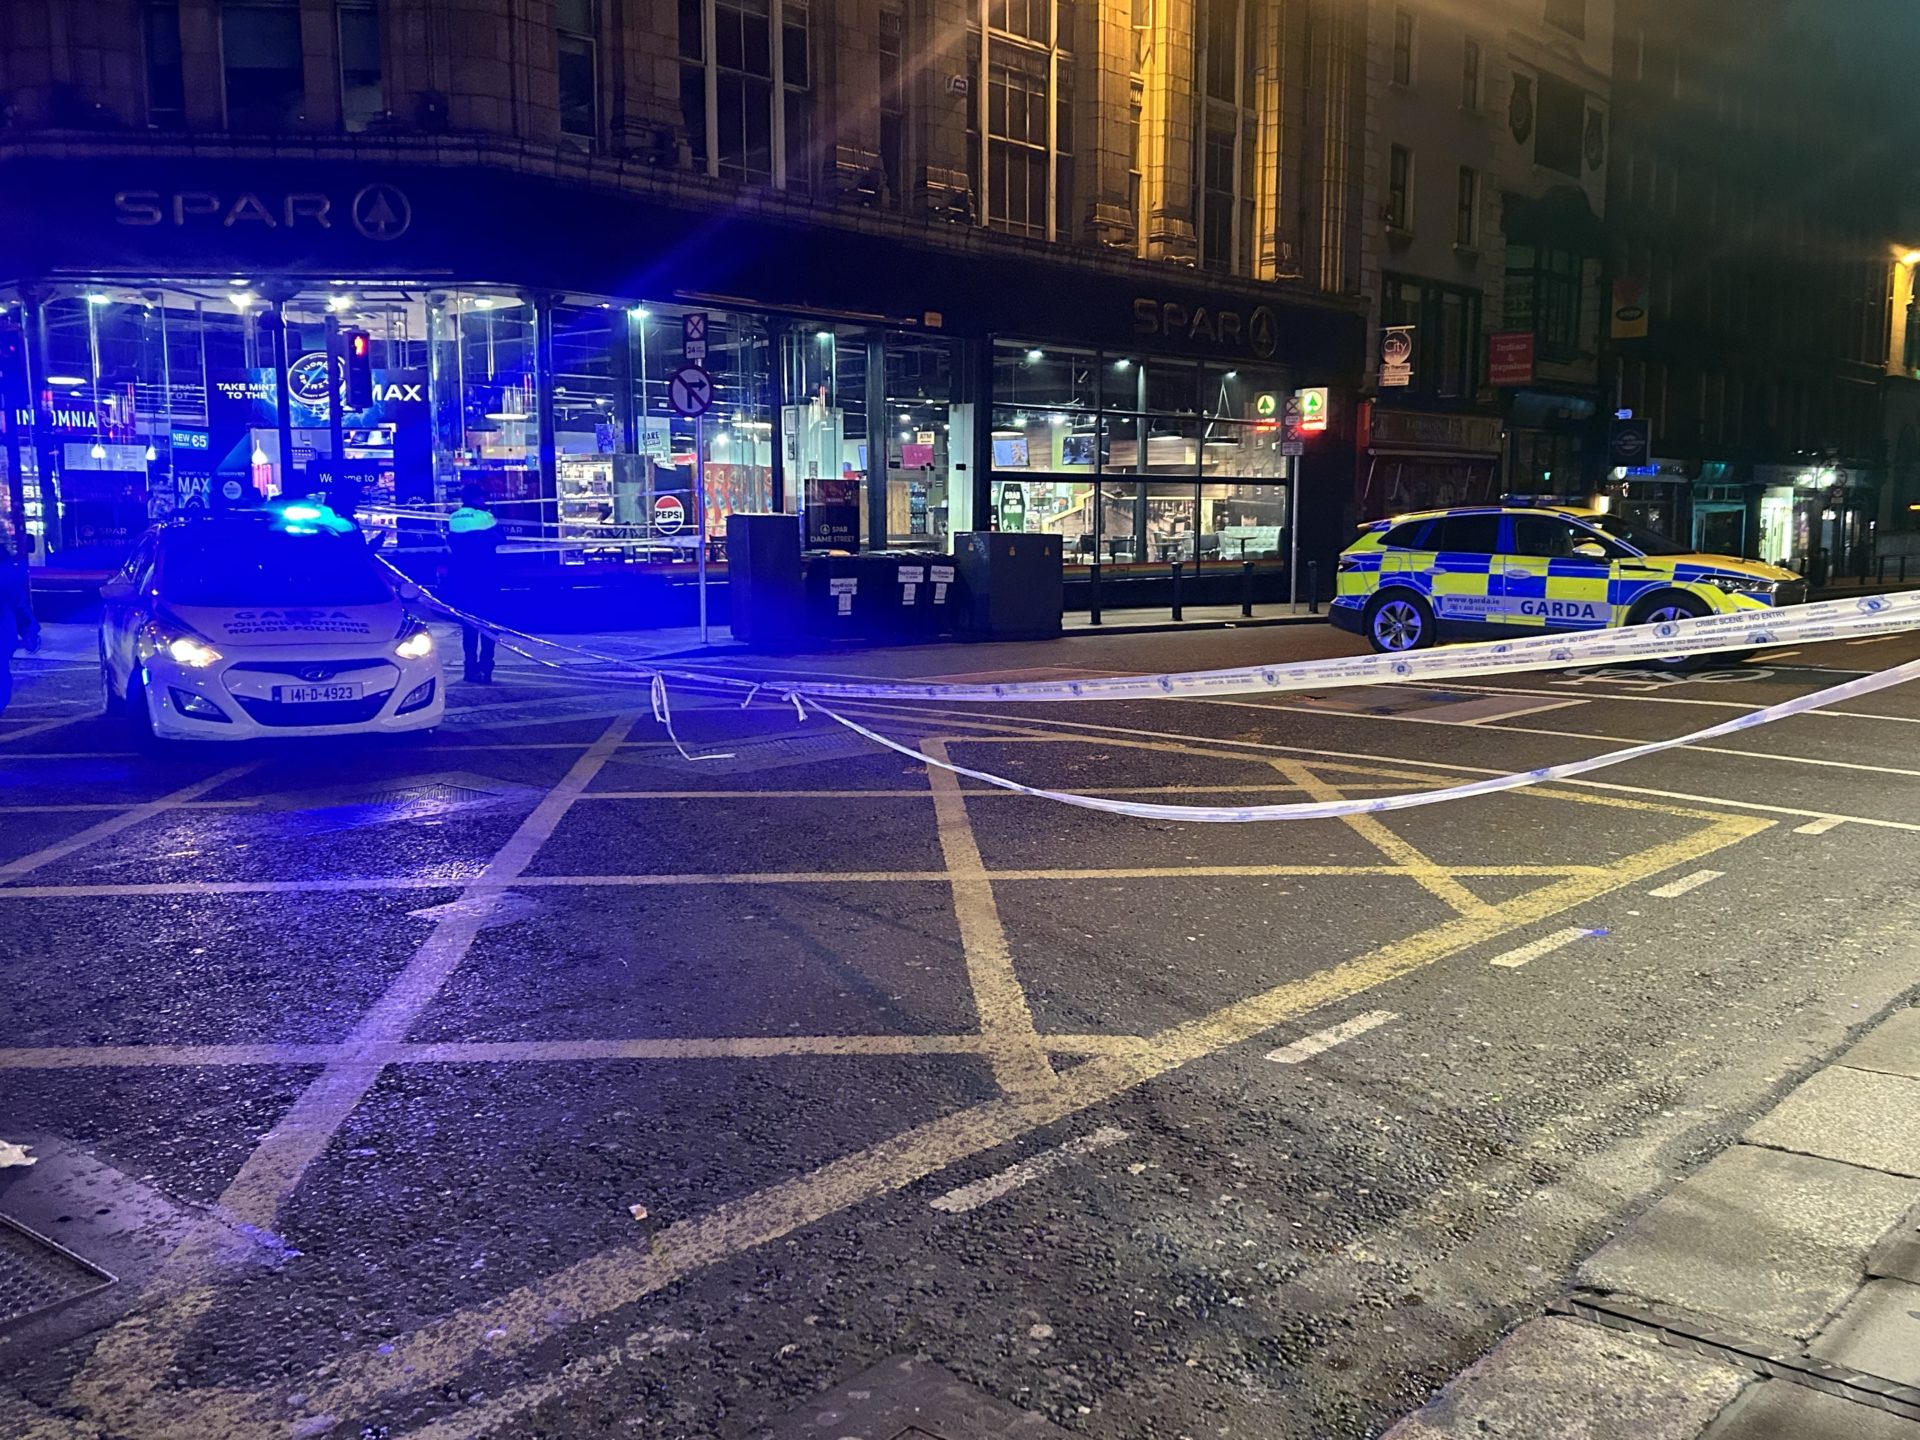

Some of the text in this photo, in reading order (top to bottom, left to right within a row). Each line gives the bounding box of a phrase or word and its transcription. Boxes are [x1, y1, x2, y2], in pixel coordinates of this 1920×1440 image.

[114, 190, 331, 227] SPAR
[1133, 298, 1242, 345] SPAR
[1384, 338, 1408, 355] City
[217, 383, 277, 391] TAKE MINT
[16, 409, 98, 428] INOMNIA
[173, 433, 190, 442] NEW
[192, 435, 208, 448] €5
[178, 477, 210, 494] MAX
[655, 510, 682, 520] PEPSI
[1447, 596, 1500, 606] www.garda.ie
[233, 611, 351, 620] GADA
[1520, 600, 1596, 619] GARDA
[1696, 610, 1787, 628] CRIME SCENE NO ENTRY
[228, 626, 371, 635] ROADS POLICING
[290, 686, 353, 702] 141-D-4923
